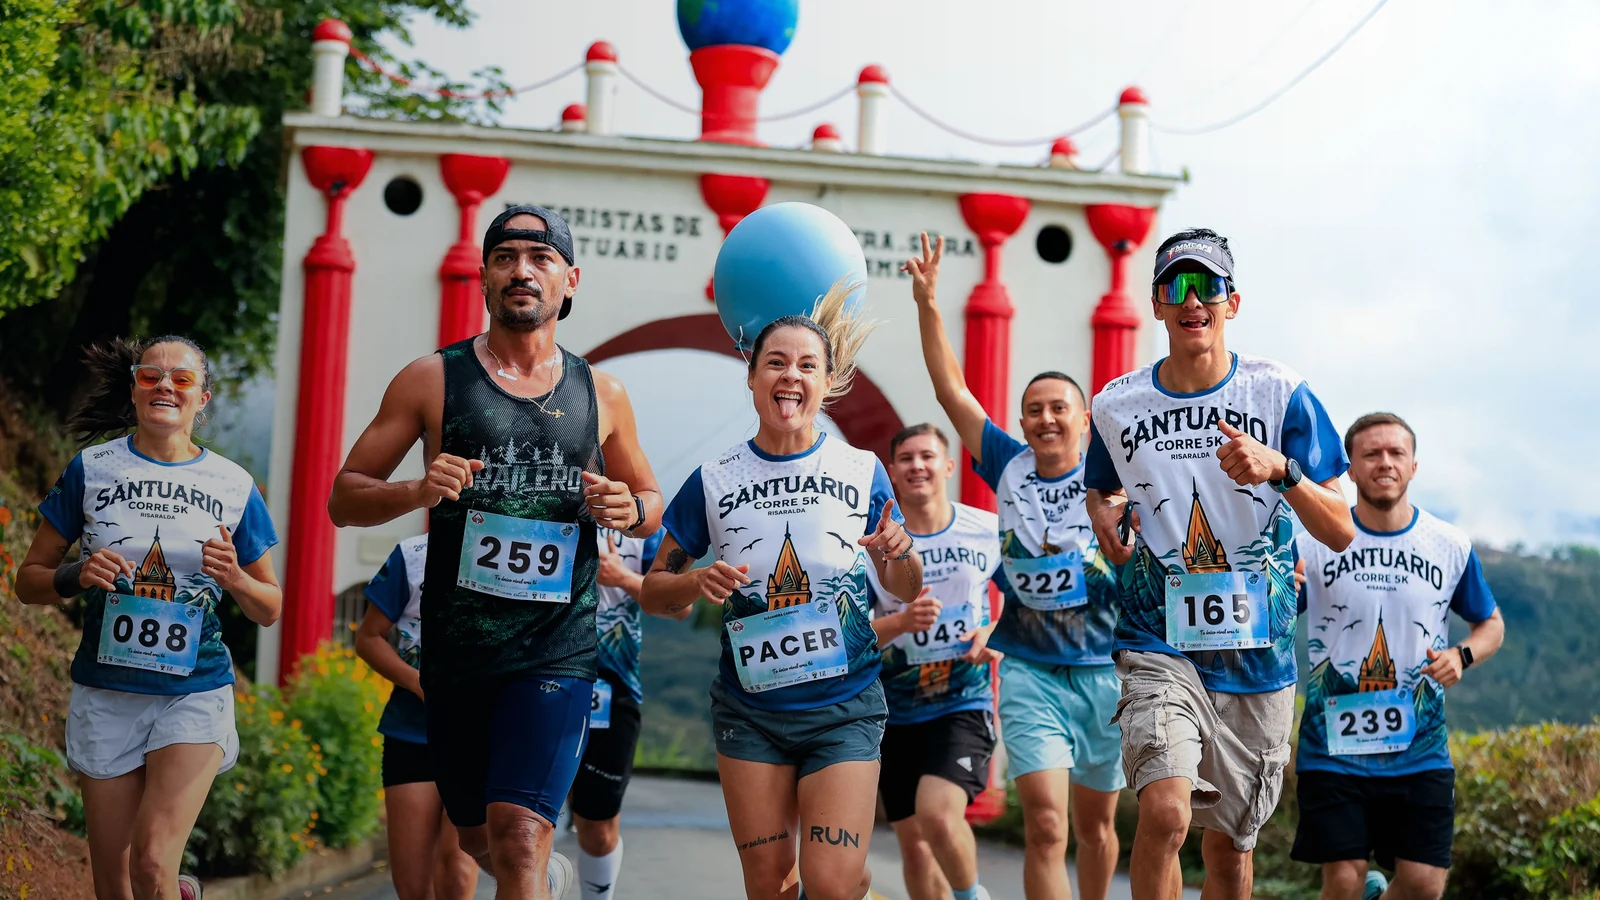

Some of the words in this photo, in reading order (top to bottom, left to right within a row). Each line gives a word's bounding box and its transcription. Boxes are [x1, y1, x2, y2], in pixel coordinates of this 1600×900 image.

[673, 215, 701, 237] DE
[577, 237, 678, 261] TUARIO
[1120, 405, 1267, 464] SANTUARIO
[1154, 438, 1203, 452] CORRE
[1205, 435, 1224, 448] 5K
[1170, 451, 1211, 461] RISARALDA
[472, 465, 583, 494] RAILERO
[94, 479, 224, 523] SANTUARIO
[127, 501, 170, 514] CORRE
[172, 503, 189, 515] 5K
[718, 474, 860, 520] SANTUARIO
[753, 497, 800, 510] CORRE
[801, 495, 820, 506] 5K
[139, 512, 176, 521] RISARALDA
[767, 507, 806, 516] RISARALDA
[476, 535, 561, 576] 259
[920, 547, 987, 573] TUARIO
[1015, 568, 1073, 594] 222
[1323, 547, 1443, 591] SANTUARIO
[1353, 572, 1392, 584] CORRE
[1394, 574, 1409, 585] 5K
[1183, 593, 1251, 627] 165
[112, 614, 188, 652] 088
[912, 619, 968, 648] 043
[738, 626, 840, 668] PACER
[1339, 706, 1401, 737] 239
[809, 825, 860, 849] RUN
